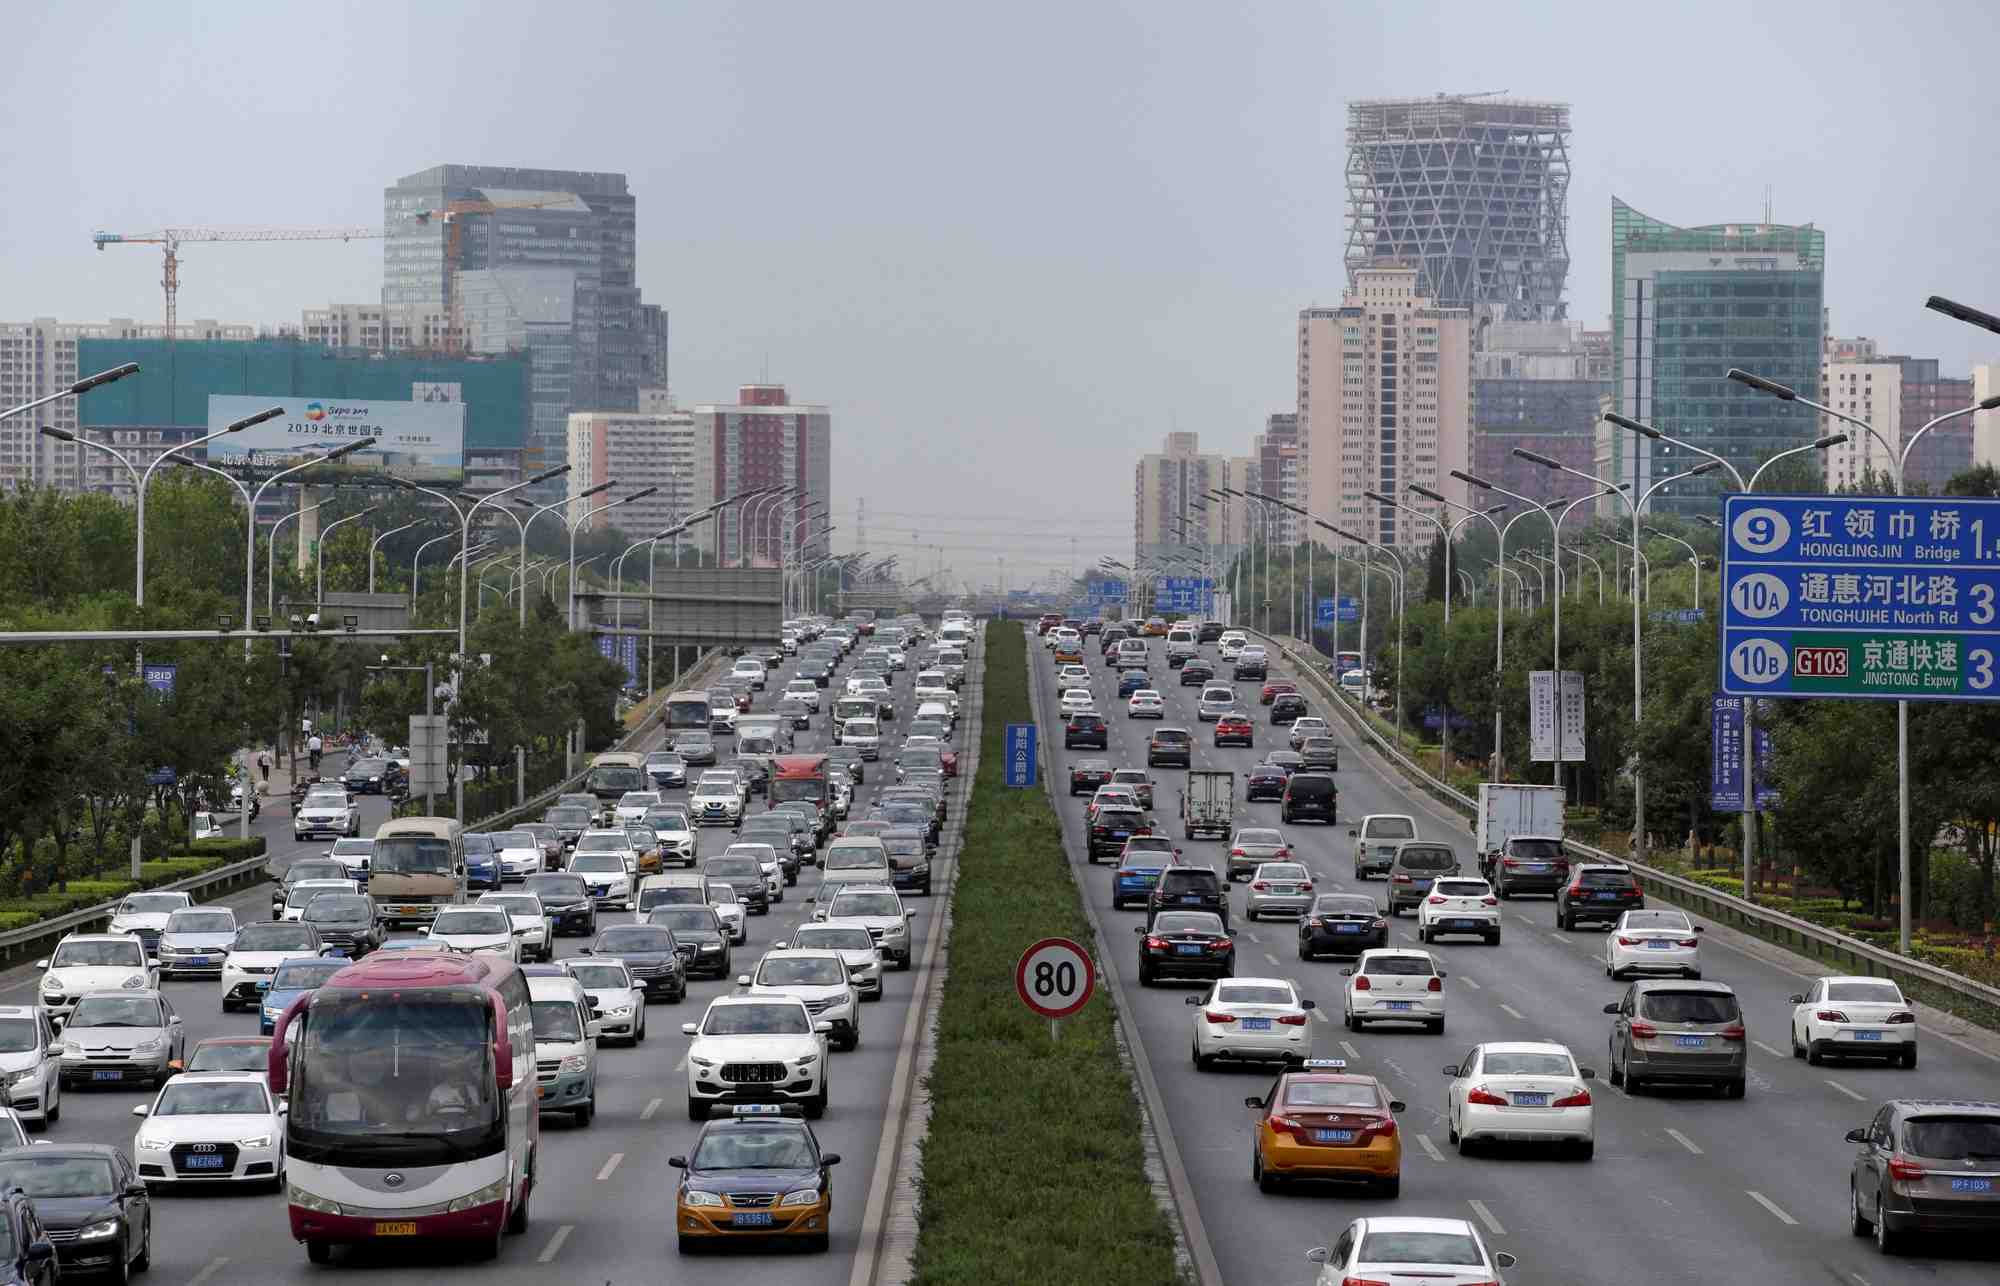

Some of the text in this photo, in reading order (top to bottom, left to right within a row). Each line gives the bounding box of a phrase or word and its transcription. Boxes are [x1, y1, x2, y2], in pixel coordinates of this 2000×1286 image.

[1747, 516, 1776, 546] 9
[1801, 509, 2000, 560] 红领巾桥 1.
[1800, 543, 1961, 562] HONGLINGJIN Bridge
[1739, 581, 1780, 611] 10A
[1800, 573, 1995, 624] 通惠河北路 3
[1800, 609, 1958, 625] TONGHUIHE North Rd
[1739, 646, 1779, 675] 10B
[1797, 640, 1994, 689] G103 京通快速 3
[1862, 672, 1958, 688] JINGTONG Expwy
[1035, 961, 1076, 997] 80
